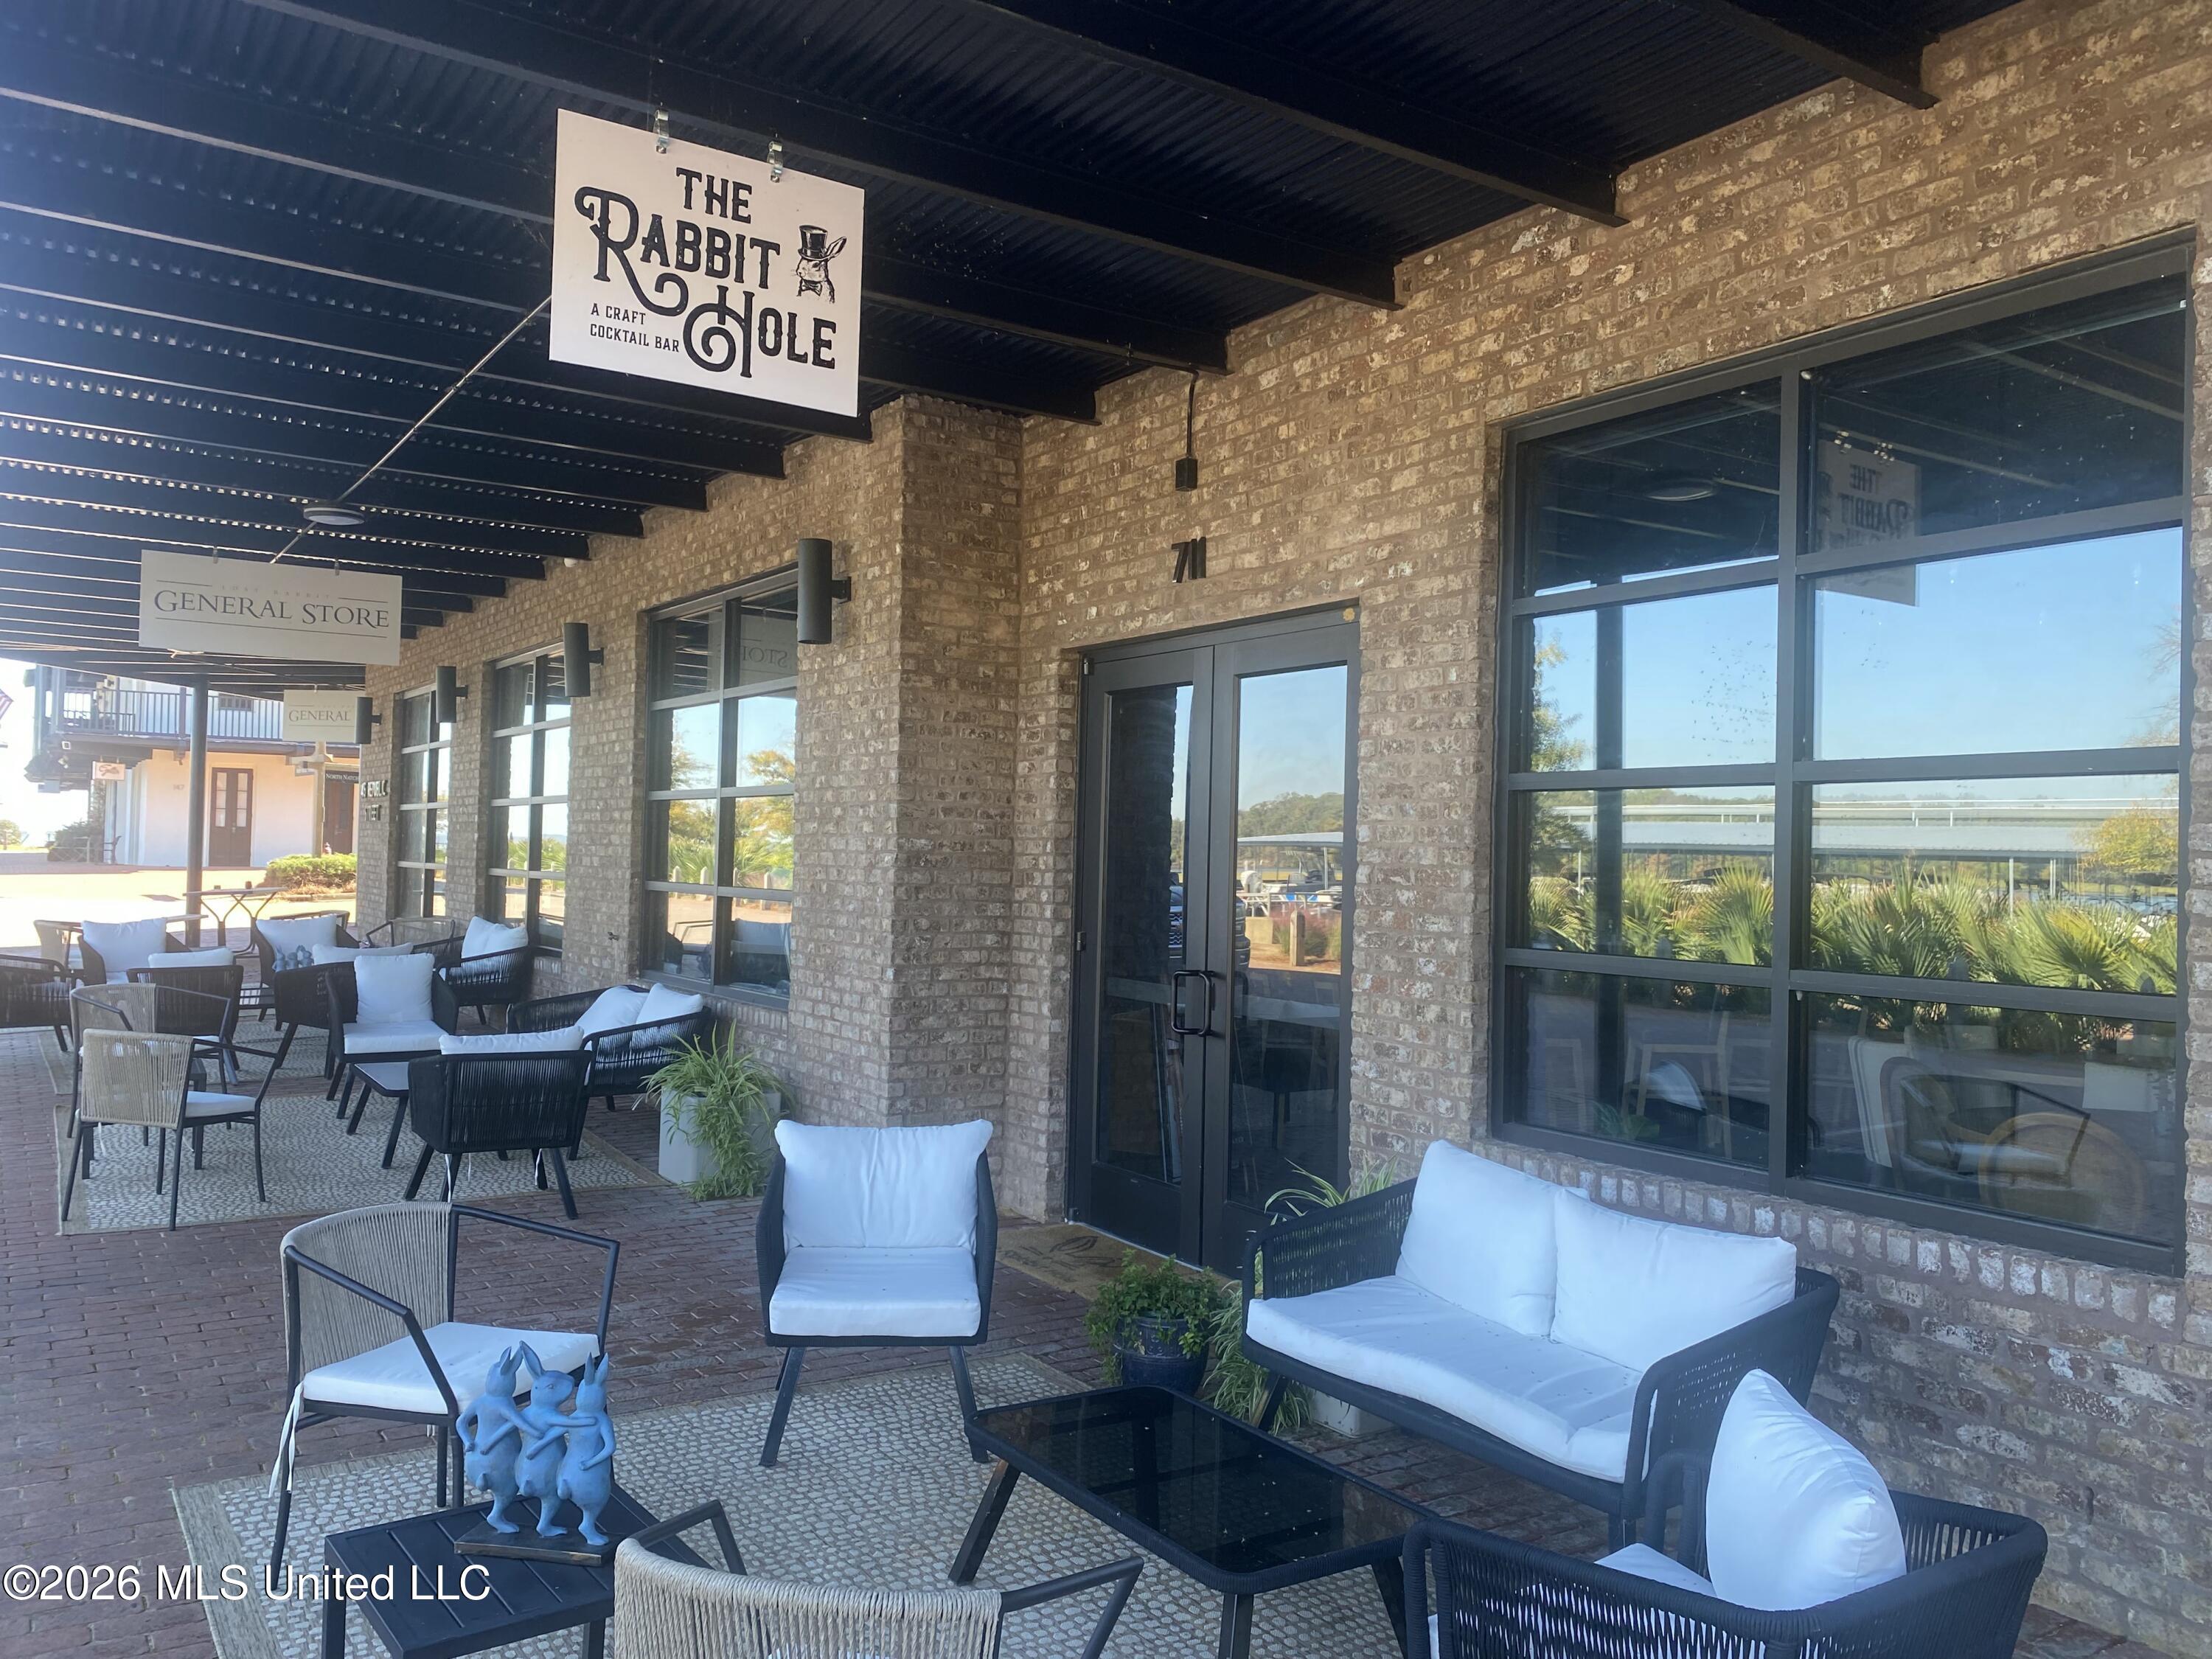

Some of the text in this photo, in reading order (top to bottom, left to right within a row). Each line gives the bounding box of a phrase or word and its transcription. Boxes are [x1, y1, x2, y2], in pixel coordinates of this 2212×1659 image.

[676, 167, 753, 224] THE
[574, 186, 780, 316] RABBIT
[591, 303, 646, 325] A CRAFT
[683, 285, 837, 378] HOLE
[590, 323, 680, 353] COCKTAIL BAR
[154, 590, 390, 629] GENERAL STORE
[288, 709, 351, 723] GENERAL
